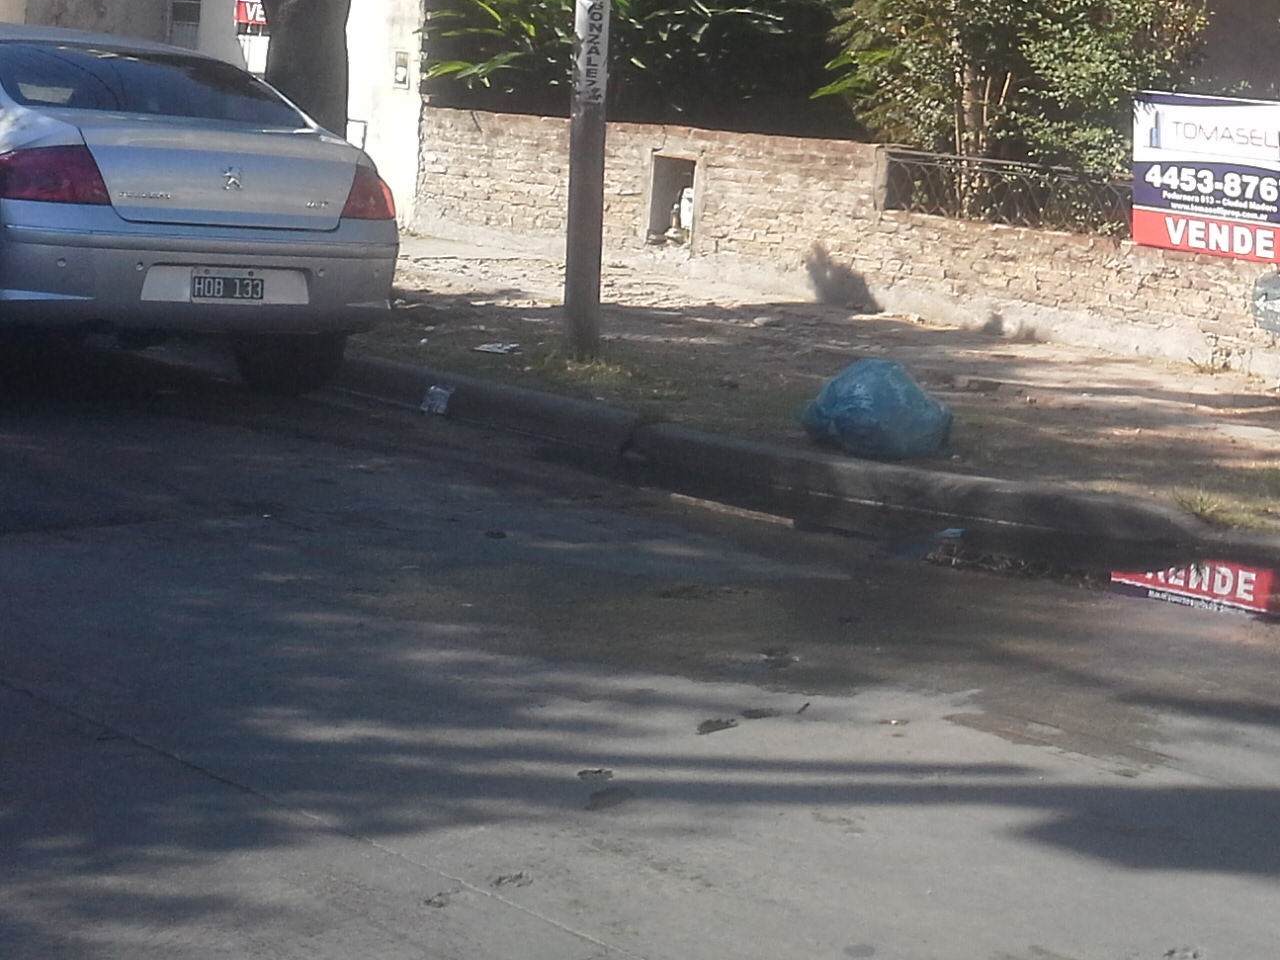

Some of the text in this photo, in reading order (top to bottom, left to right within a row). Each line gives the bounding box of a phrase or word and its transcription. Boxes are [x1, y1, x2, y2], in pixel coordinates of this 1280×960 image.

[1164, 217, 1275, 259] VENDE
[194, 278, 262, 299] HOB 133
